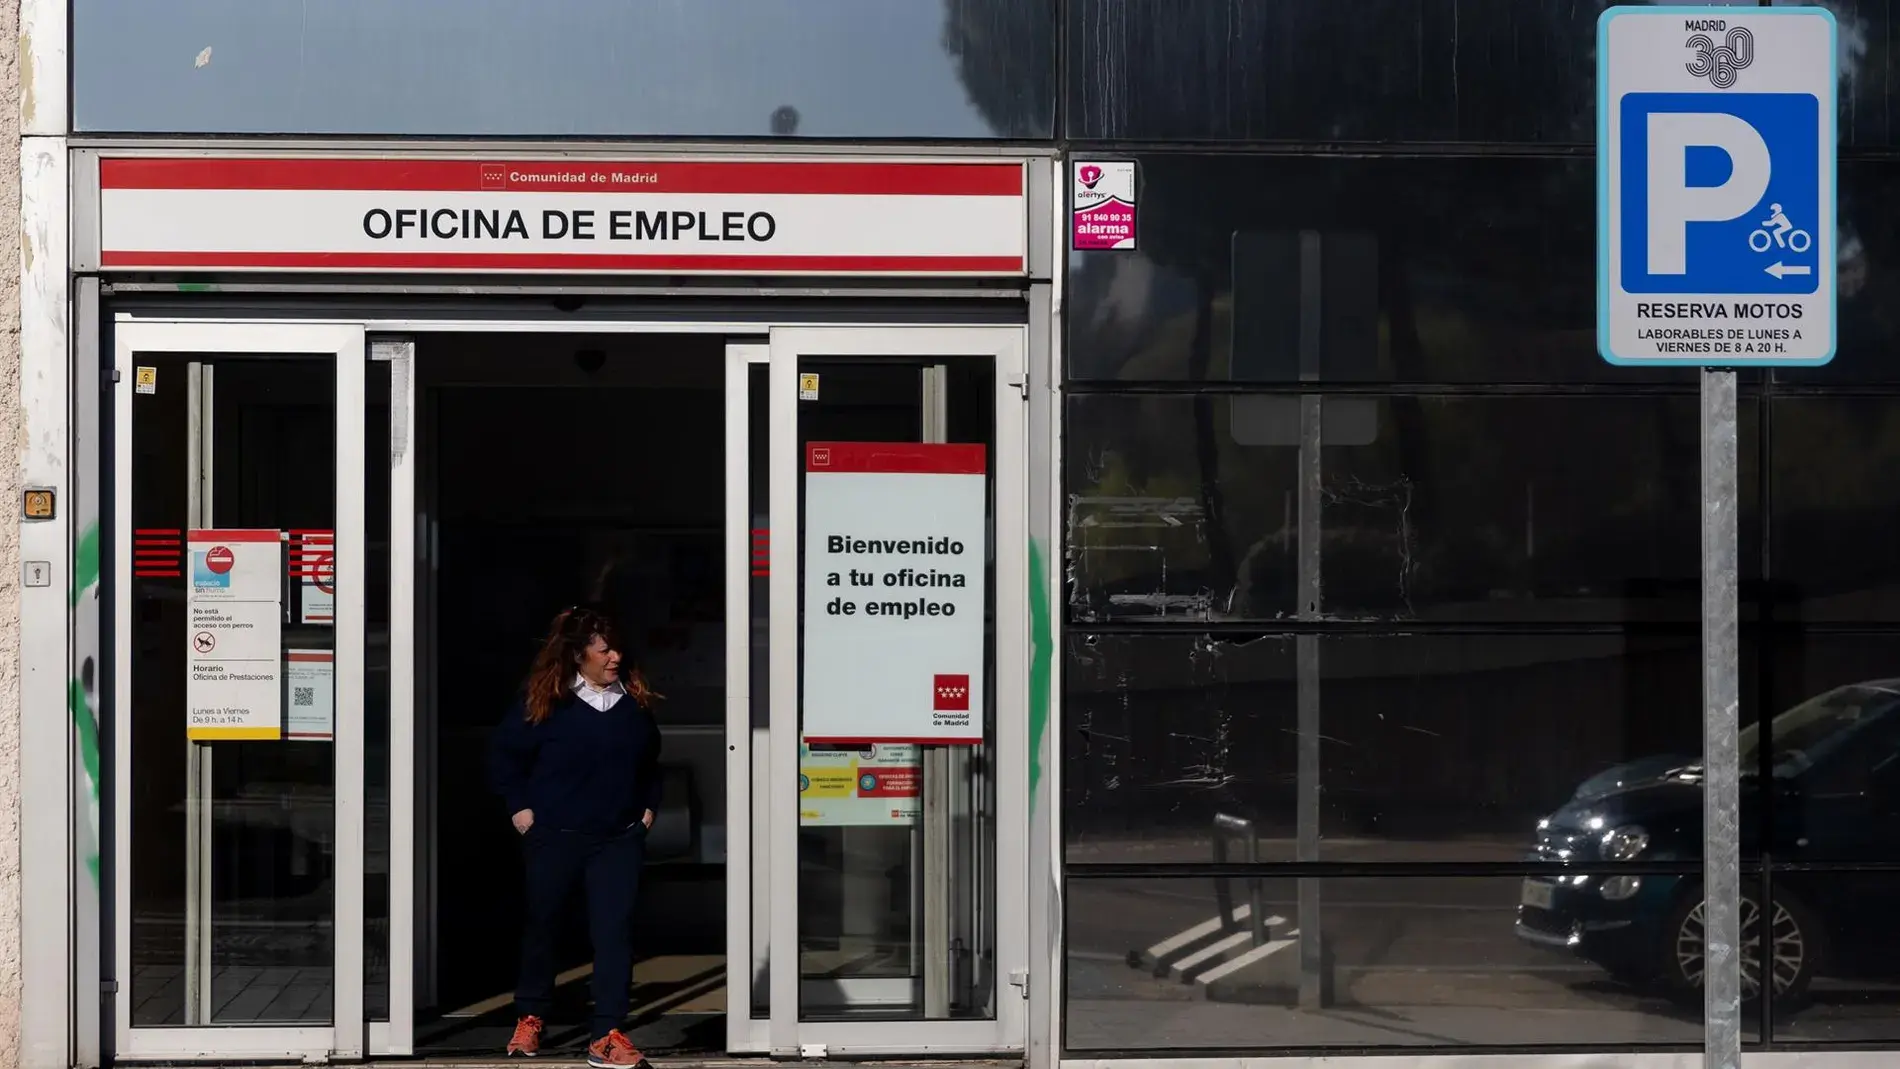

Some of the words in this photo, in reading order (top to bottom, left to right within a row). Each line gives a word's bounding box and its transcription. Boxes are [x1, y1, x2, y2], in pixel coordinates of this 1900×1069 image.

[1685, 20, 1726, 31] MADRID
[1685, 26, 1754, 88] 360
[510, 171, 586, 183] Comunidad
[590, 172, 606, 183] de
[611, 172, 658, 184] Madrid
[1077, 191, 1104, 200] alertys
[1647, 112, 1771, 275] P
[1081, 213, 1092, 222] 91
[1093, 213, 1108, 222] 840
[1110, 213, 1120, 222] 90
[1121, 213, 1132, 222] 35
[363, 208, 529, 239] OFICINA
[542, 209, 595, 240] DE
[609, 209, 776, 242] EMPLEO
[1077, 222, 1129, 234] alarma
[1637, 303, 1728, 318] RESERVA
[1734, 303, 1803, 319] MOTOS
[1638, 329, 1724, 339] LABORABLES
[1727, 329, 1744, 340] DE
[1748, 329, 1790, 340] LUNES
[1793, 330, 1802, 340] A
[1656, 342, 1711, 353] VIERNES
[1714, 342, 1731, 353] DE
[1735, 343, 1742, 353] 8
[1745, 343, 1754, 353] A
[1758, 343, 1771, 353] 20
[1775, 343, 1787, 353] H.
[827, 535, 964, 555] Bienvenido
[827, 572, 840, 586] a
[849, 569, 874, 586] tu
[883, 569, 966, 587] oficina
[827, 597, 856, 615] de
[865, 598, 956, 620] empleo
[193, 673, 217, 681] Oficina
[219, 673, 228, 681] de
[229, 673, 274, 681] Prestaciones
[193, 707, 215, 715] Lunes
[223, 707, 250, 715] Viernes
